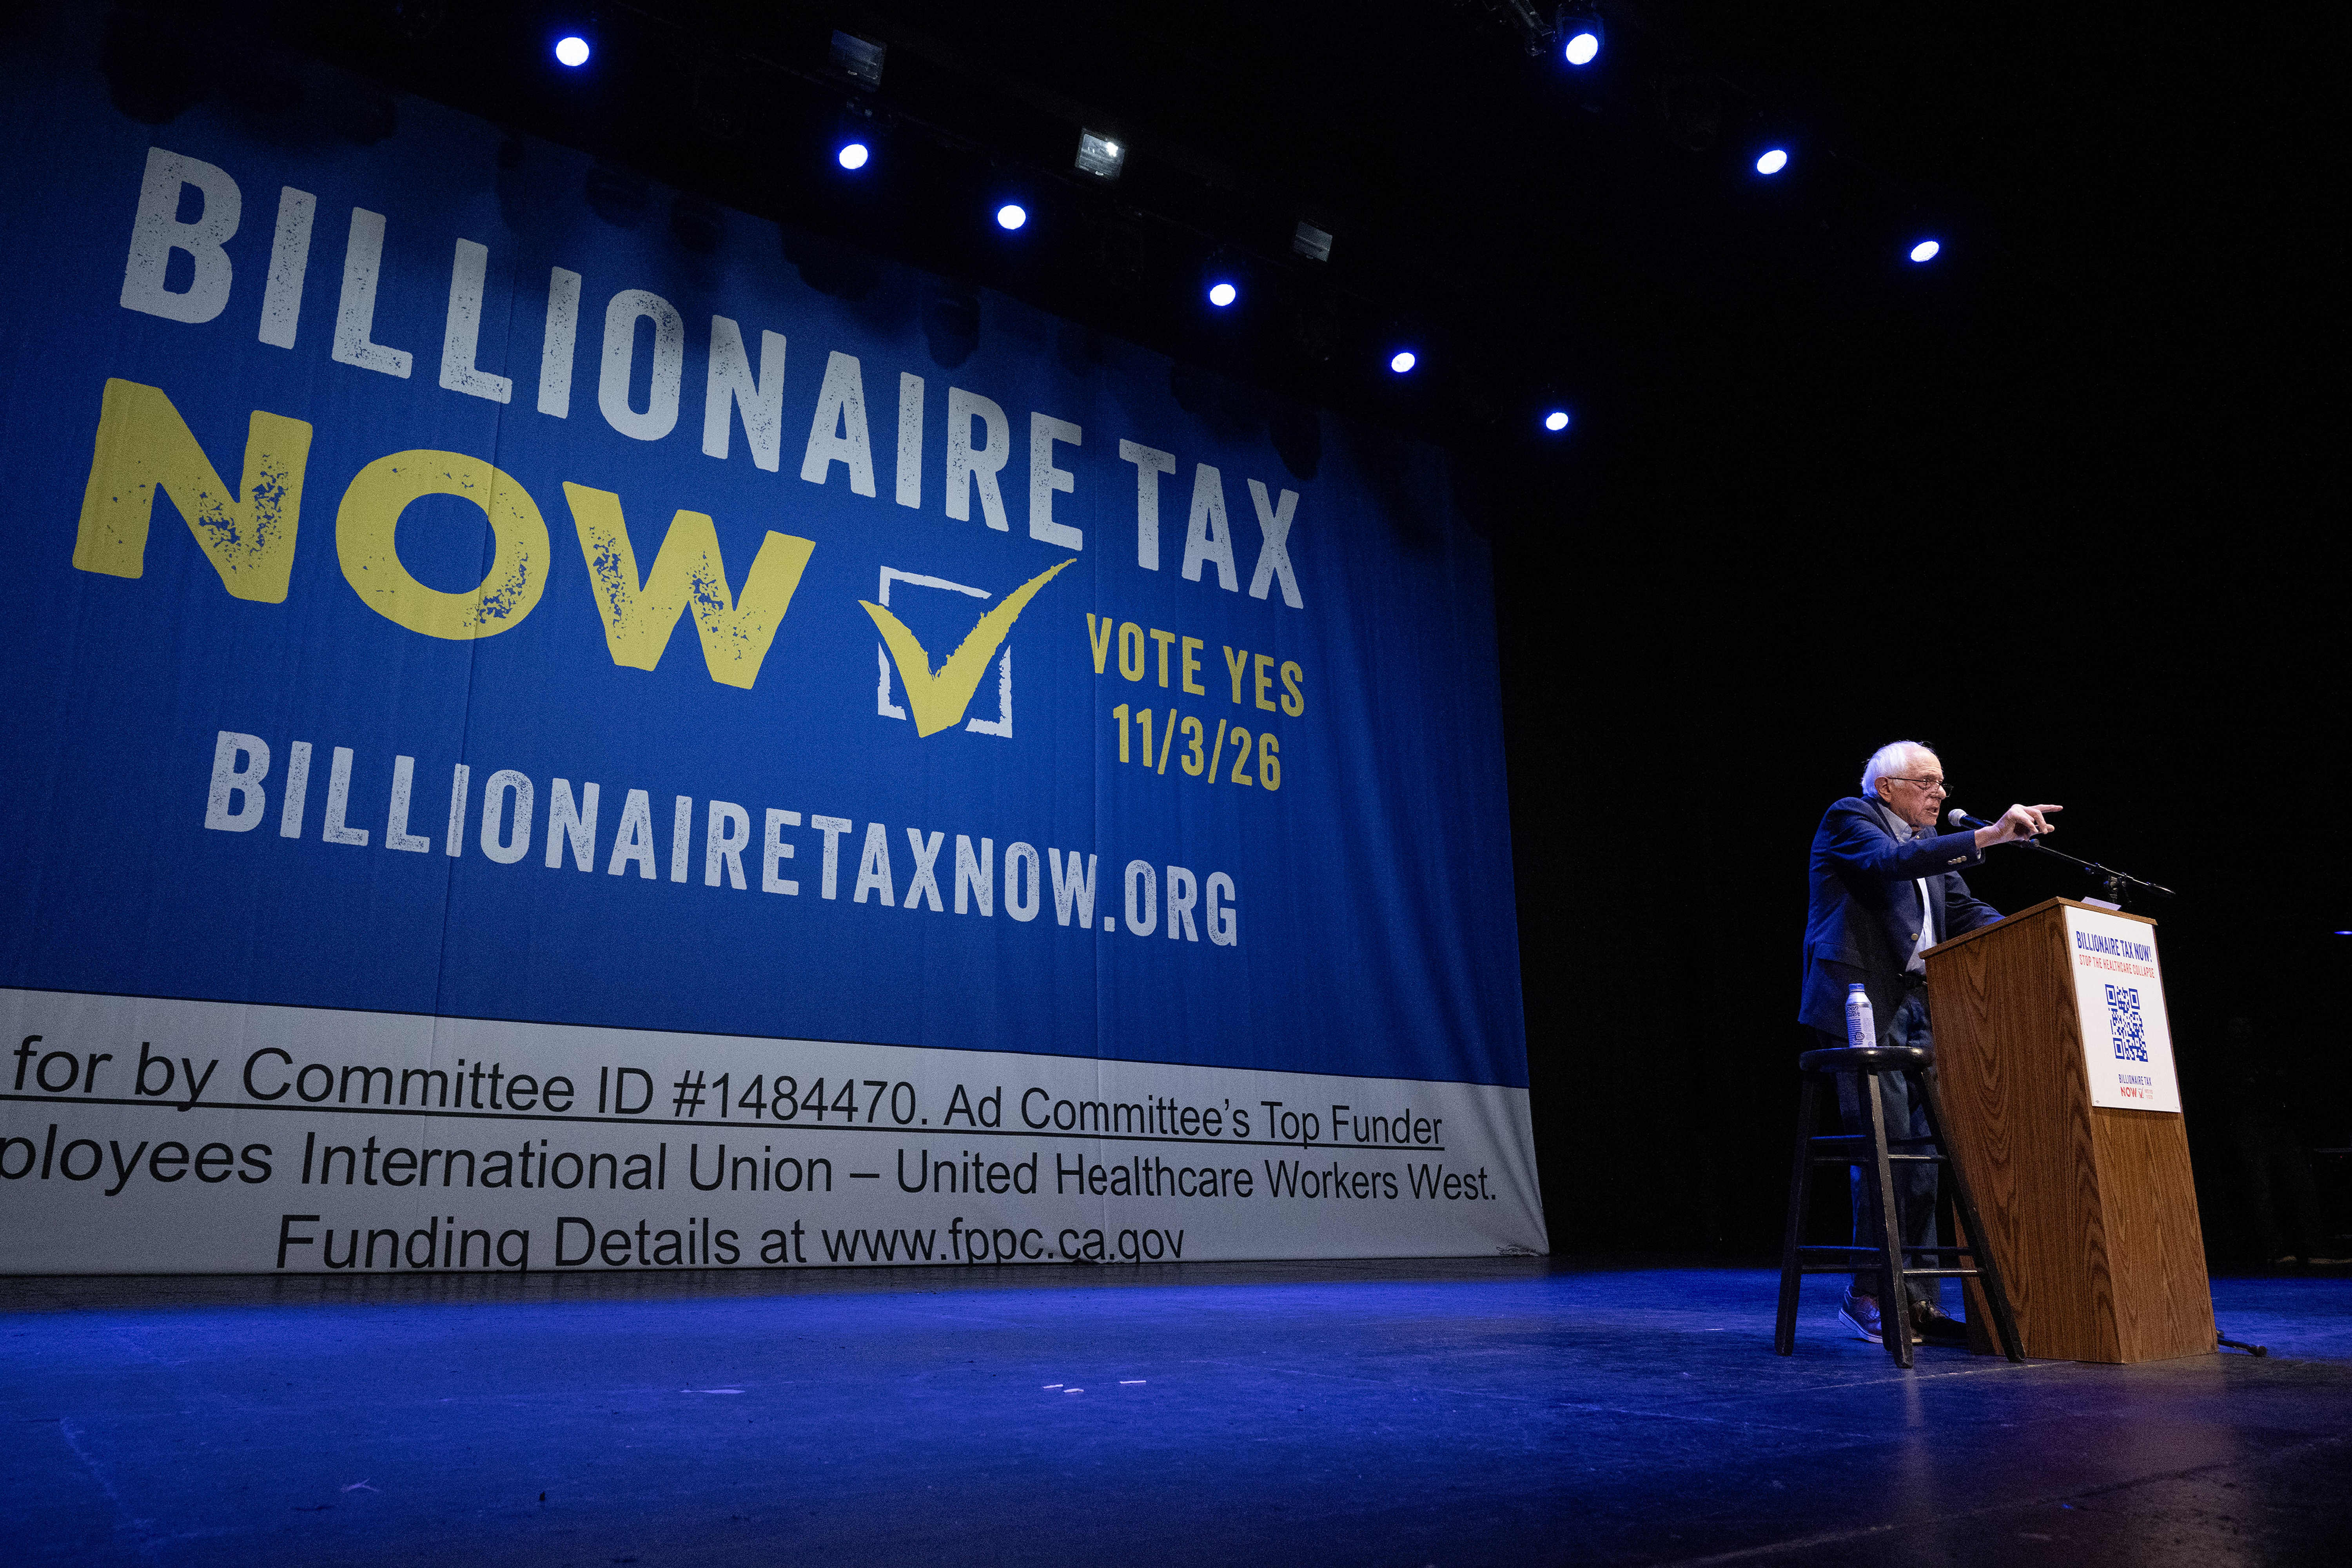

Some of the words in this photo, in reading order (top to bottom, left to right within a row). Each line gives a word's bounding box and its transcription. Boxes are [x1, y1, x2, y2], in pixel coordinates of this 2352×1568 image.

[120, 148, 1083, 552] BILLIONAIRE
[1119, 438, 1305, 610] TAX
[72, 377, 817, 691] NOW
[1086, 612, 1205, 696] VOTE
[1222, 645, 1305, 718] YES
[1112, 702, 1281, 792] 11/3/26
[204, 730, 1238, 947] BILLIONAIRETAXNOW.ORG
[2076, 931, 2120, 956] BILLIONAIRE
[2120, 940, 2134, 959] TAX
[2134, 943, 2152, 962] NOW!
[2079, 954, 2091, 966] STOP
[2092, 957, 2103, 969] THE
[2103, 958, 2132, 974] HEALTHCARE
[2132, 964, 2155, 978] COLLAPSE
[13, 1035, 113, 1093] for
[135, 1042, 218, 1112] by
[243, 1047, 574, 1112] Committee
[599, 1066, 653, 1114] ID
[673, 1070, 927, 1125] #1484470.
[944, 1084, 1001, 1127] Ad
[1022, 1087, 1250, 1138] Committee’s
[1261, 1101, 1319, 1149] Top
[1332, 1105, 1442, 1144] Funder
[2118, 1074, 2144, 1085] BILLIONAIRE
[2120, 1086, 2137, 1098] NOW
[301, 1132, 666, 1190] International
[690, 1143, 831, 1192] Union
[898, 1149, 1037, 1194] United
[1056, 1153, 1253, 1198] Healthcare
[1265, 1160, 1399, 1200] Workers
[1407, 1163, 1496, 1200] West.
[276, 1214, 529, 1271] Funding
[555, 1216, 740, 1267] Details
[760, 1220, 807, 1264] at
[822, 1217, 1184, 1265] www.fppc.ca.gov
